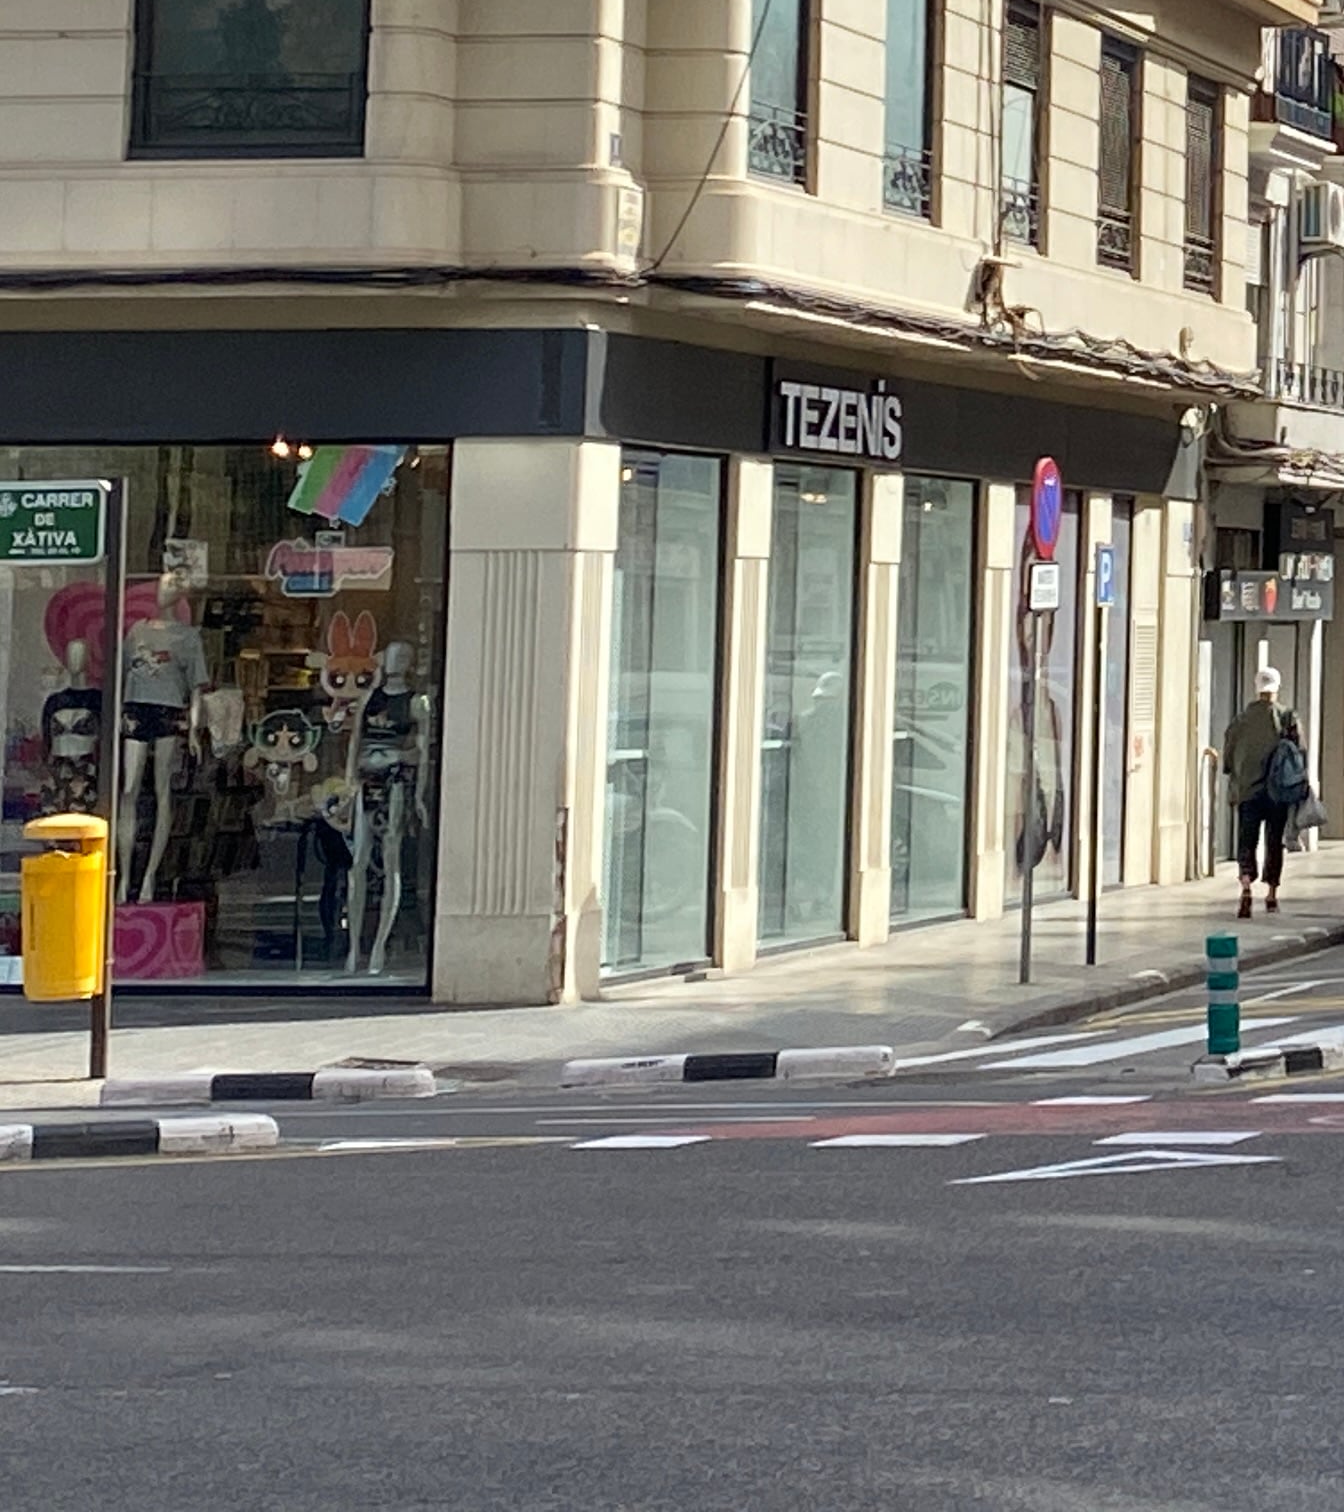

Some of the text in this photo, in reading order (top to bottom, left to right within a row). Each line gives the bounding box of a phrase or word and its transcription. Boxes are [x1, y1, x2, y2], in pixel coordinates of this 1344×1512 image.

[780, 378, 902, 460] TEZENIS
[21, 492, 93, 508] CARRER
[34, 512, 55, 526] DE
[12, 527, 77, 547] XÀTIVA
[1100, 551, 1112, 598] P
